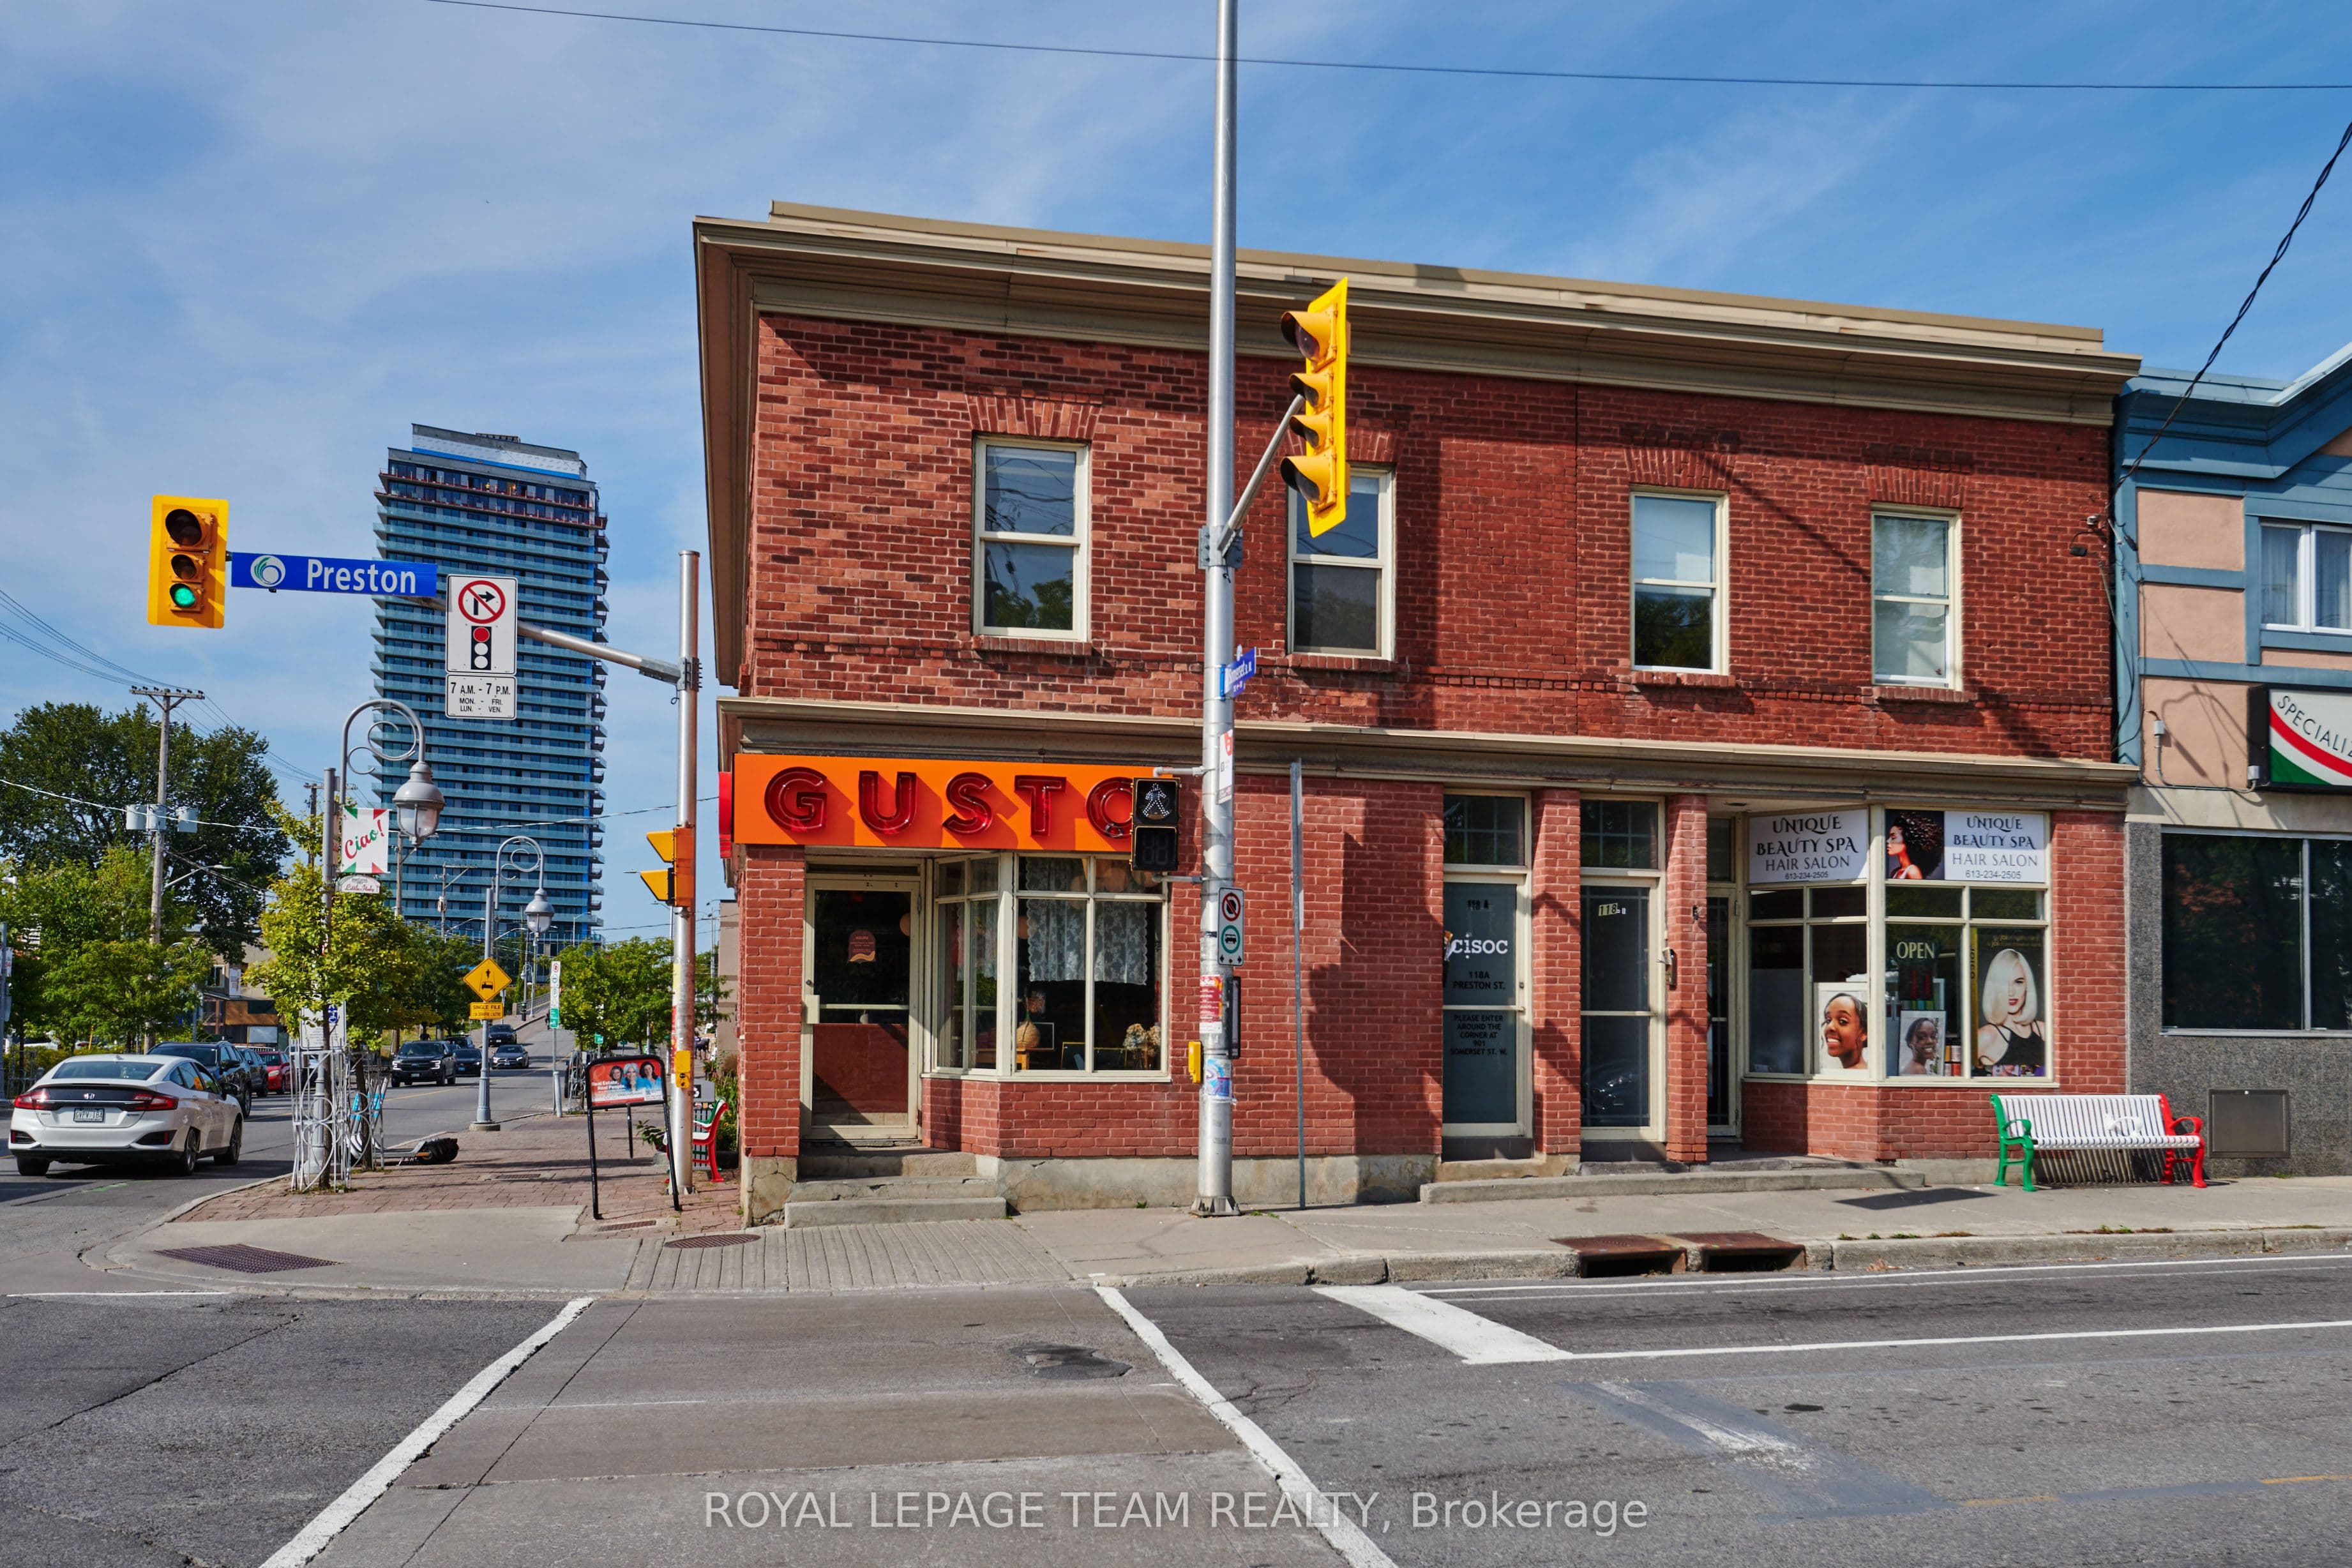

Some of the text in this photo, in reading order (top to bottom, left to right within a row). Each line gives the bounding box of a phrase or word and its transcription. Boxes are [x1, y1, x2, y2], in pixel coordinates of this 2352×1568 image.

[307, 559, 416, 594] Preston
[451, 682, 456, 694] 7
[460, 685, 476, 695] A.M.
[486, 682, 492, 695] 7
[496, 686, 511, 695] P.M.
[764, 766, 1133, 839] GUSTO
[1772, 814, 1842, 834] UNIQUE
[1966, 815, 2023, 833] UNIQUE
[345, 819, 384, 859] Ciao!
[1756, 836, 1858, 857] BEAUTY SPA
[1954, 833, 2037, 850] BEAUTY SPA
[1766, 856, 1850, 871] HAIR SALON
[1952, 852, 2038, 868] HAIR SALON
[1784, 871, 1828, 880] 613-234-2505
[1965, 870, 2021, 879] 613-234-2505
[1600, 903, 1617, 915] 118
[1451, 933, 1508, 959] cisoc
[1896, 941, 1935, 959] OPEN
[1469, 971, 1490, 979] 118A
[1453, 981, 1491, 990] PRESTON
